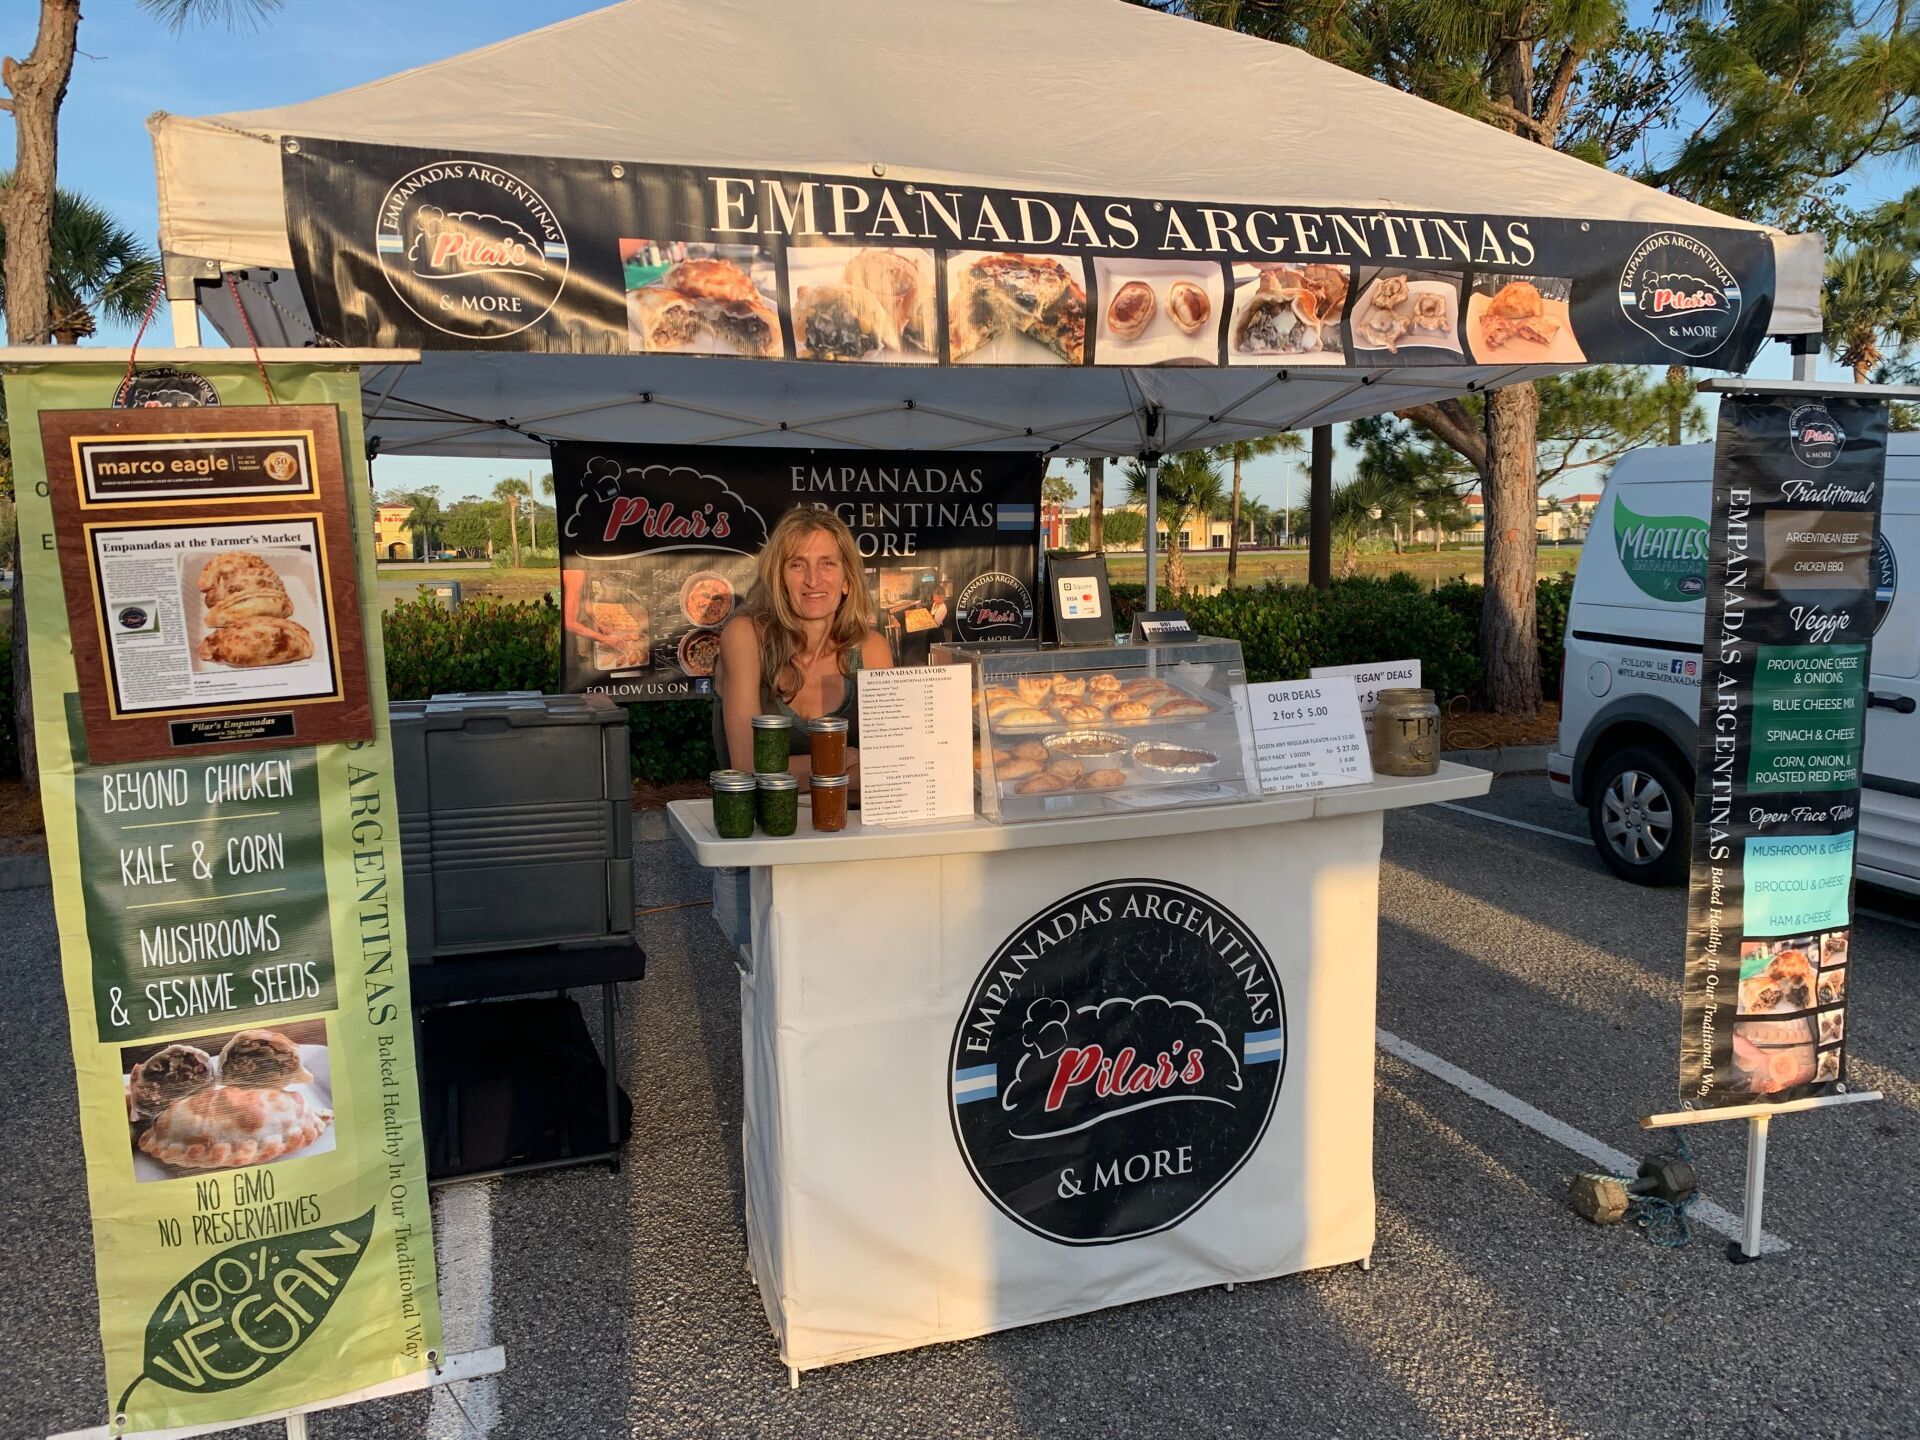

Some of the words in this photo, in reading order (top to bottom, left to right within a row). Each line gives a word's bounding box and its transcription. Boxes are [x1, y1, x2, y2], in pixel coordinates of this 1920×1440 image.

[383, 166, 463, 230] EMPANADAS
[468, 167, 560, 241] ARGENTINAS
[708, 176, 1139, 250] EMPANADAS
[1158, 206, 1535, 267] ARGENTINAS
[431, 231, 527, 267] Pilar's
[1623, 235, 1670, 288] EMPANADAS
[1672, 236, 1733, 287] ARGENTINAS
[439, 294, 454, 311] &
[462, 295, 522, 312] MORE
[1669, 326, 1680, 337] &
[1682, 326, 1717, 338] MORE
[98, 460, 165, 475] marco
[171, 455, 229, 475] eagle
[790, 466, 984, 493] EMPANADAS
[1781, 479, 1875, 505] Traditional
[602, 496, 731, 542] Pilar's
[103, 540, 172, 553] Empanadas
[175, 541, 185, 549] at
[187, 538, 207, 548] the
[211, 535, 259, 547] Farmer's
[262, 533, 302, 544] Market
[1786, 532, 1841, 543] ARGENTINEAN
[1632, 560, 1703, 573] EMPANADAS
[1720, 487, 1752, 665] EMPANADAS
[1794, 561, 1826, 572] CHICKEN
[1828, 561, 1844, 572] BBQ
[960, 574, 994, 609] EMPANADAS
[995, 575, 1031, 609] ARGENTINAS
[1790, 604, 1850, 643] Veggie
[870, 669, 913, 677] EMPANADAS
[1387, 670, 1412, 680] DEALS
[1621, 658, 1654, 668] FOLLOW
[1657, 662, 1668, 671] US
[1767, 659, 1834, 670] PROVOLONE
[1834, 657, 1858, 669] CHEESE
[586, 684, 643, 695] FOLLOW
[647, 683, 664, 694] US
[668, 683, 689, 694] ON
[1618, 668, 1701, 687] @PILARSEMPANADAS
[1793, 673, 1802, 684] &
[1804, 672, 1844, 684] ONIONS
[1268, 692, 1290, 703] OUR
[1292, 688, 1321, 701] DEALS
[1773, 699, 1801, 711] BLUE
[1803, 699, 1843, 710] CHEESE
[1844, 698, 1855, 709] MIX
[192, 722, 222, 731] Pilar's
[223, 717, 275, 730] Empanadas
[1272, 711, 1279, 721] 2
[1281, 709, 1295, 720] for
[1297, 708, 1304, 719] $
[1307, 706, 1328, 717] 5.00
[1767, 730, 1813, 741] SPINACH
[1815, 730, 1823, 740] &
[1825, 728, 1855, 740] CHEESE
[1709, 672, 1738, 860] ARGENTINAS
[1773, 756, 1805, 768] CORN,
[1807, 755, 1846, 767] ONION,
[103, 769, 188, 814] BEYOND
[205, 760, 293, 804] CHICKEN
[1755, 771, 1806, 783] ROASTED
[1809, 771, 1831, 782] RED
[1749, 807, 1790, 830] Open
[1791, 806, 1828, 822] Face
[120, 845, 176, 886] KALE
[191, 840, 213, 880] &
[227, 832, 285, 875] CORN
[1752, 845, 1817, 856] MUSHROOM
[1819, 844, 1826, 855] &
[347, 764, 397, 1027] ARGENTINAS
[1711, 867, 1723, 905] Baked
[1755, 880, 1808, 892] BROCCOLI
[1811, 880, 1817, 890] &
[1704, 908, 1722, 955] Healthy
[1769, 915, 1793, 926] HAM
[1795, 915, 1801, 926] &
[139, 914, 281, 968] MUSHROOMS
[966, 896, 1113, 1053] EMPANADAS
[1120, 893, 1274, 1025] ARGENTINAS
[1708, 957, 1720, 971] In
[110, 987, 130, 1026] &
[145, 973, 236, 1022] SESAME
[252, 961, 320, 1006] SEEDS
[1705, 975, 1719, 998] Our
[1701, 1002, 1718, 1068] Traditional
[378, 1035, 395, 1087] Baked
[1044, 1040, 1205, 1112] Pilar's
[1696, 1072, 1714, 1097] Way
[381, 1092, 403, 1158] Healthy
[390, 1163, 405, 1183] In
[1057, 1168, 1086, 1199] &
[1092, 1146, 1193, 1192] MORE
[196, 1181, 221, 1212] NO
[234, 1169, 275, 1207] GMO
[390, 1185, 407, 1219] Our
[158, 1218, 182, 1248] NO
[194, 1194, 321, 1246] PRESERVATIVES
[394, 1223, 419, 1320] Traditional
[162, 1246, 280, 1325] 100%
[153, 1230, 362, 1387] VEGAN
[401, 1323, 422, 1360] Way
